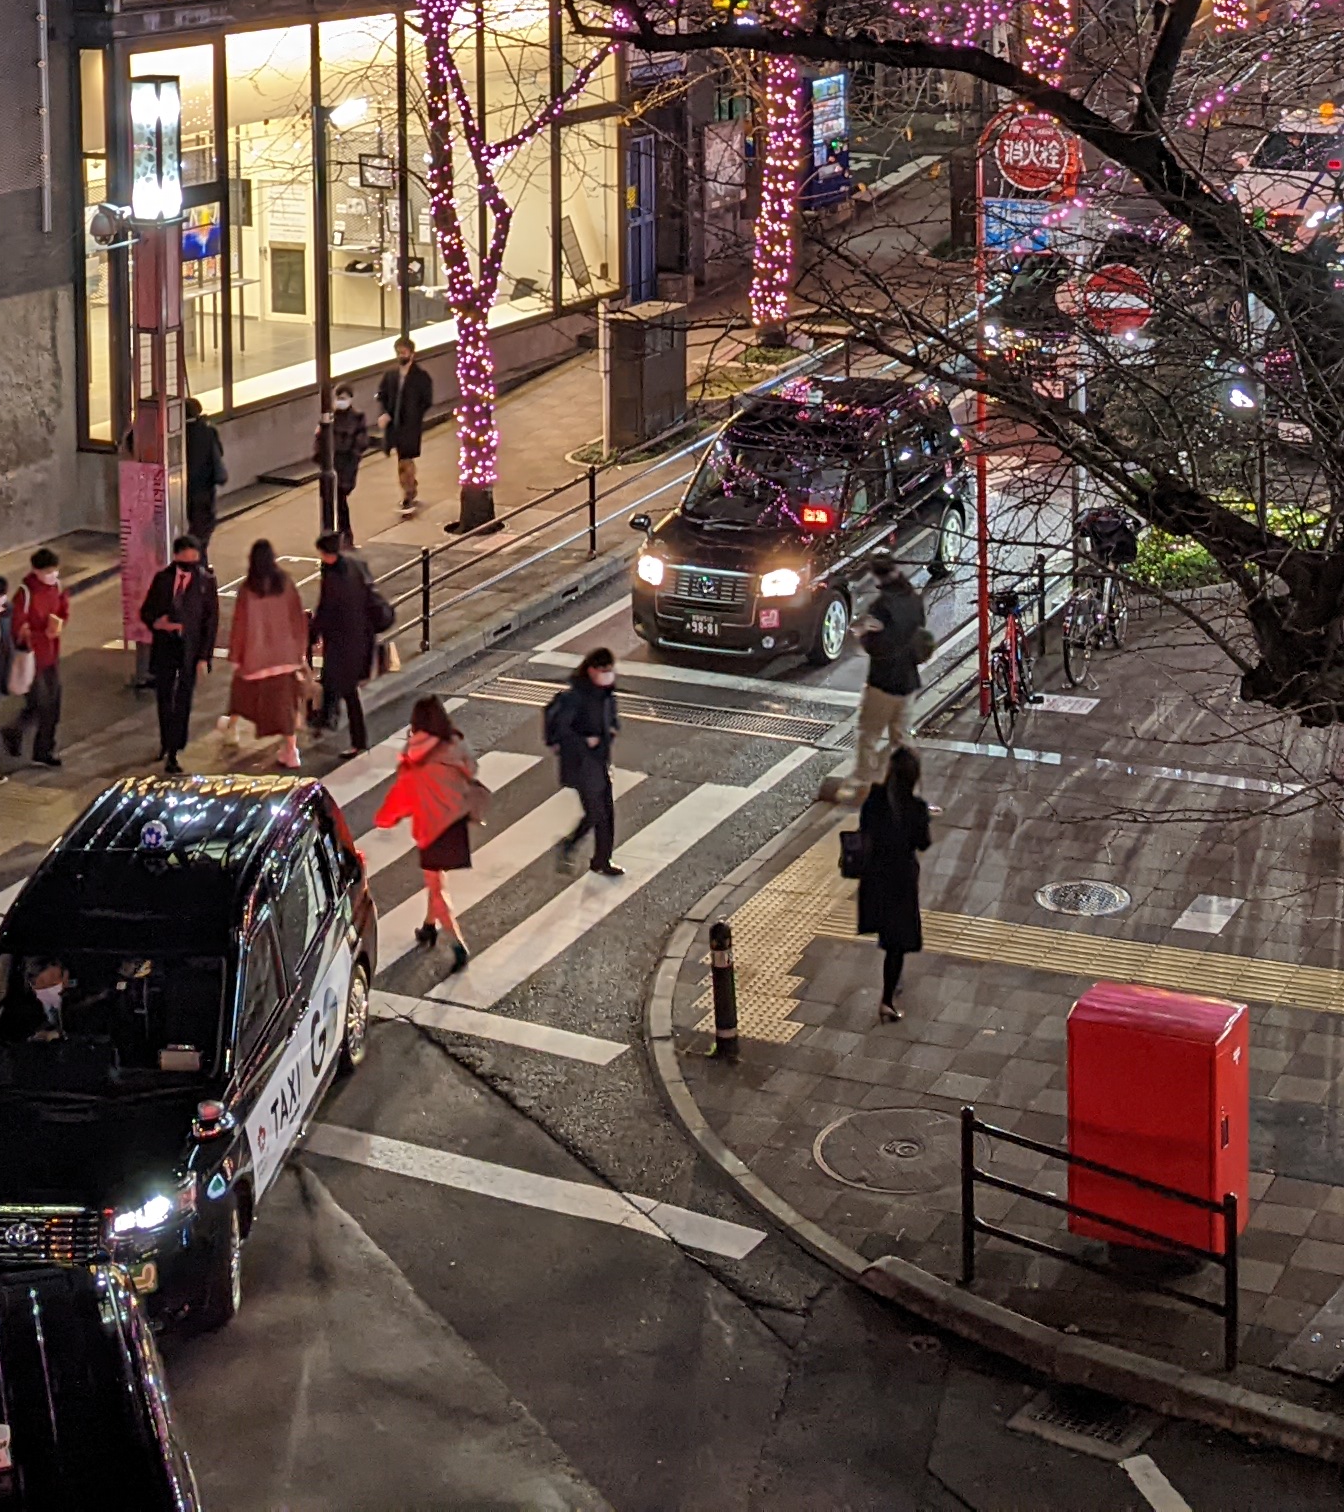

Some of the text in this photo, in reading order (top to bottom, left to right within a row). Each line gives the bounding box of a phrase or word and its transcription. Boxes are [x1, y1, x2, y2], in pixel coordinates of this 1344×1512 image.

[1003, 138, 1061, 169] 消火栓
[270, 1061, 301, 1139] TAXI
